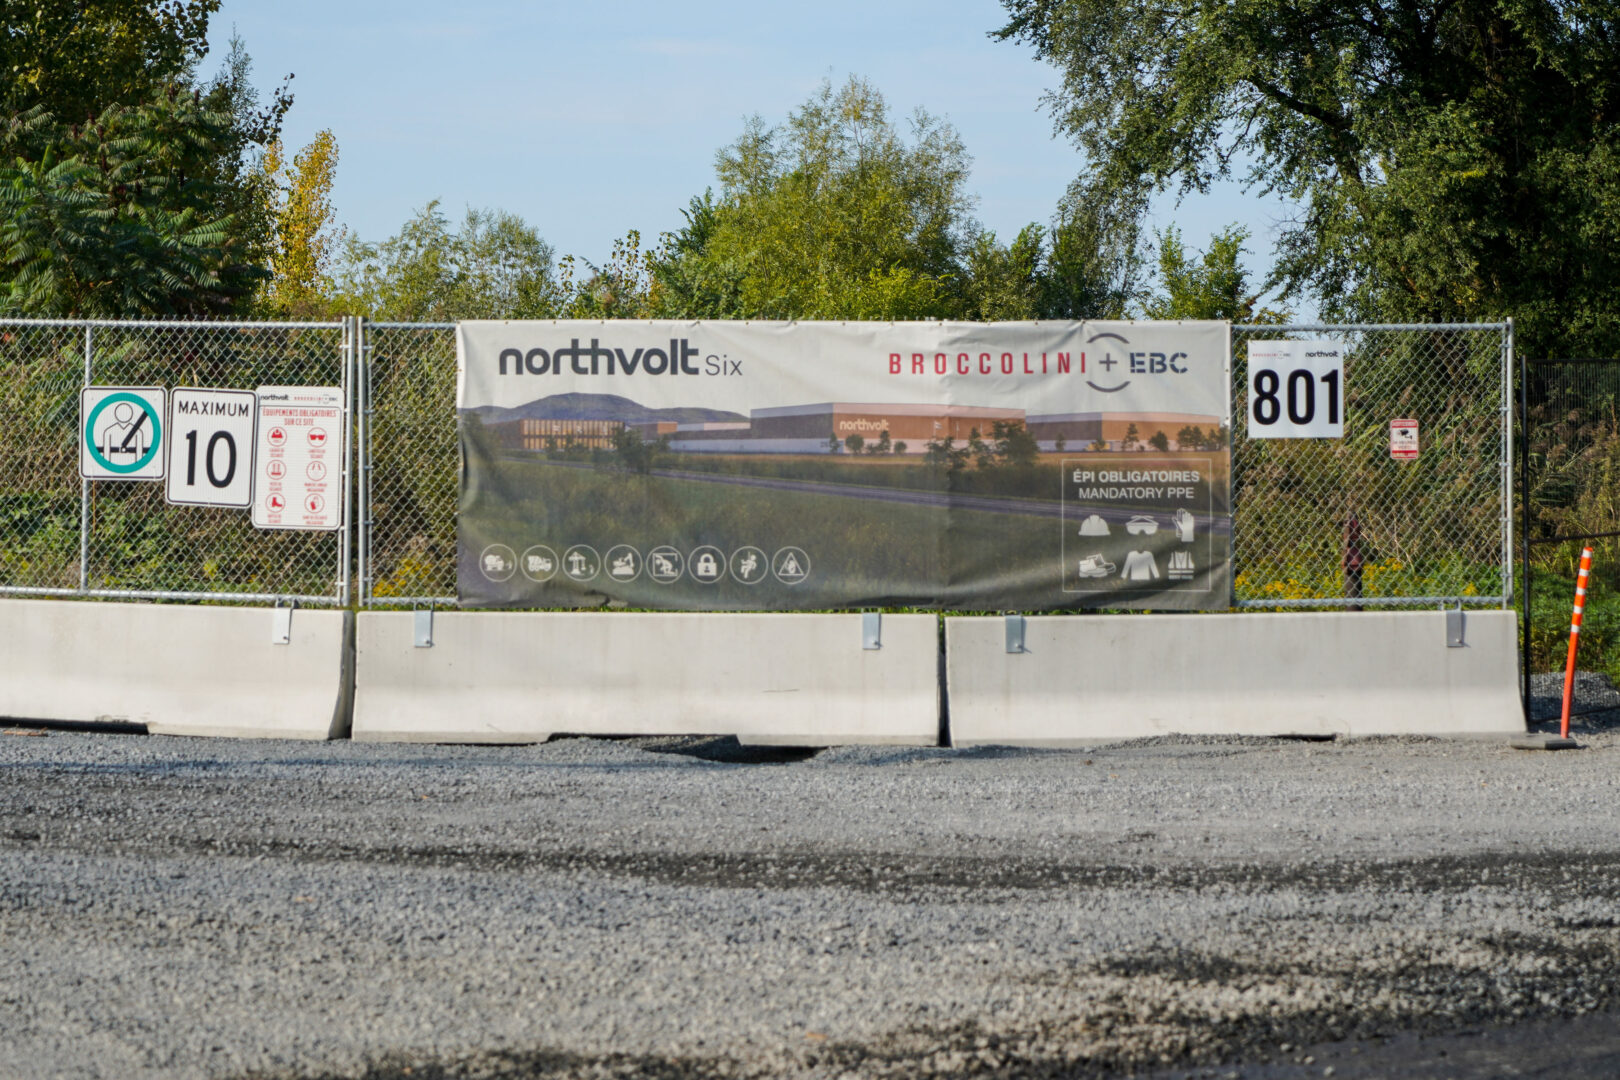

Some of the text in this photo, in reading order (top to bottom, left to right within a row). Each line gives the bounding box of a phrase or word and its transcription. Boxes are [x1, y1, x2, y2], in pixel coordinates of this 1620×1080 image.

[500, 338, 743, 376] northvolt Six
[1305, 350, 1339, 358] northvolt
[888, 352, 1086, 375] BROCCOLINI
[1129, 352, 1188, 374] EBC
[1252, 368, 1339, 426] 801
[178, 400, 249, 417] MAXIMUM
[840, 418, 890, 431] northvolt
[185, 429, 237, 488] 10
[1073, 468, 1200, 483] ÉPI OBLIGATOIRES
[1078, 487, 1195, 499] MANDATORY PPE
